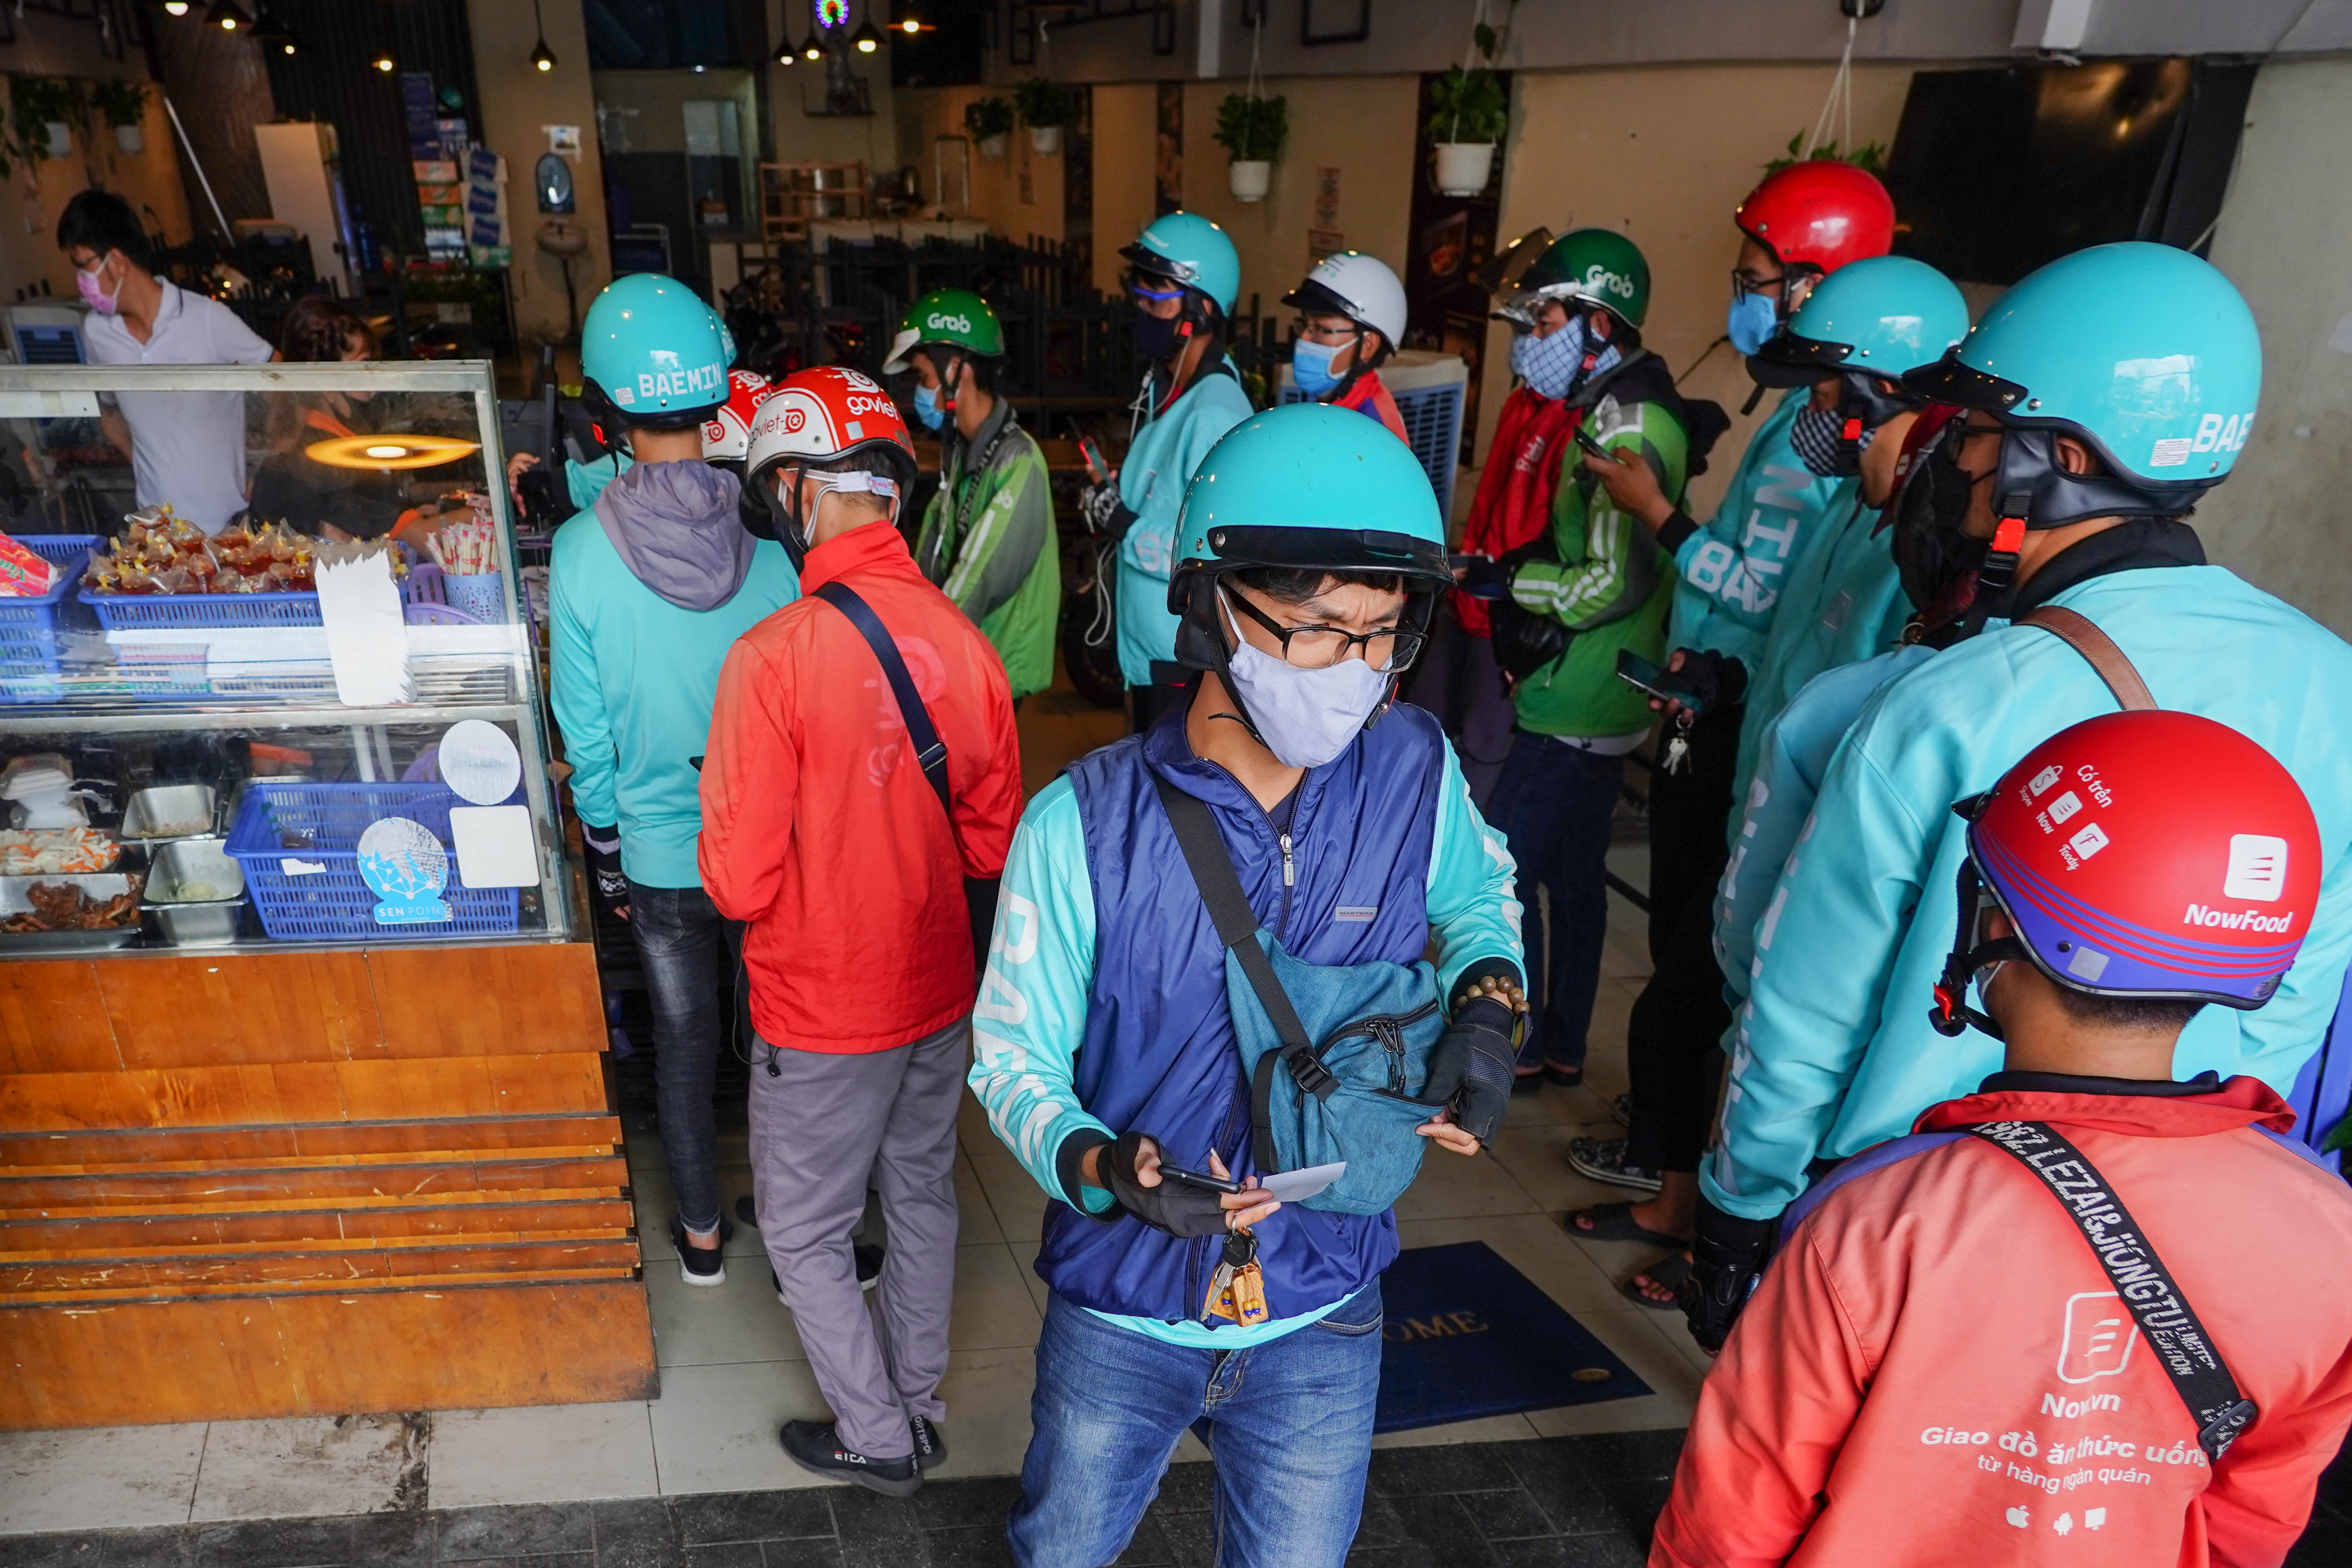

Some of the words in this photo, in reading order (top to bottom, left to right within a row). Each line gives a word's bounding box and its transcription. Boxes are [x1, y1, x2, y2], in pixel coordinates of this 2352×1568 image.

[1586, 264, 1634, 299] Grab
[927, 312, 971, 333] Grab
[638, 362, 723, 397] BAEMIN
[2077, 765, 2099, 782] Có
[2088, 780, 2112, 807] trên
[2036, 811, 2054, 834] Now
[2058, 844, 2079, 871] Foody
[379, 907, 405, 917] SEN
[2183, 903, 2293, 933] NowFood
[1920, 1427, 1989, 1445] Giao
[1998, 1430, 2038, 1457] đồ
[2046, 1442, 2075, 1465] ăn
[2076, 1435, 2136, 1458] thức
[2144, 1440, 2206, 1467] uống
[1977, 1454, 2002, 1472] từ
[2006, 1461, 2060, 1494] hàng
[2063, 1467, 2093, 1491] ngàn
[2097, 1467, 2151, 1485] quán
